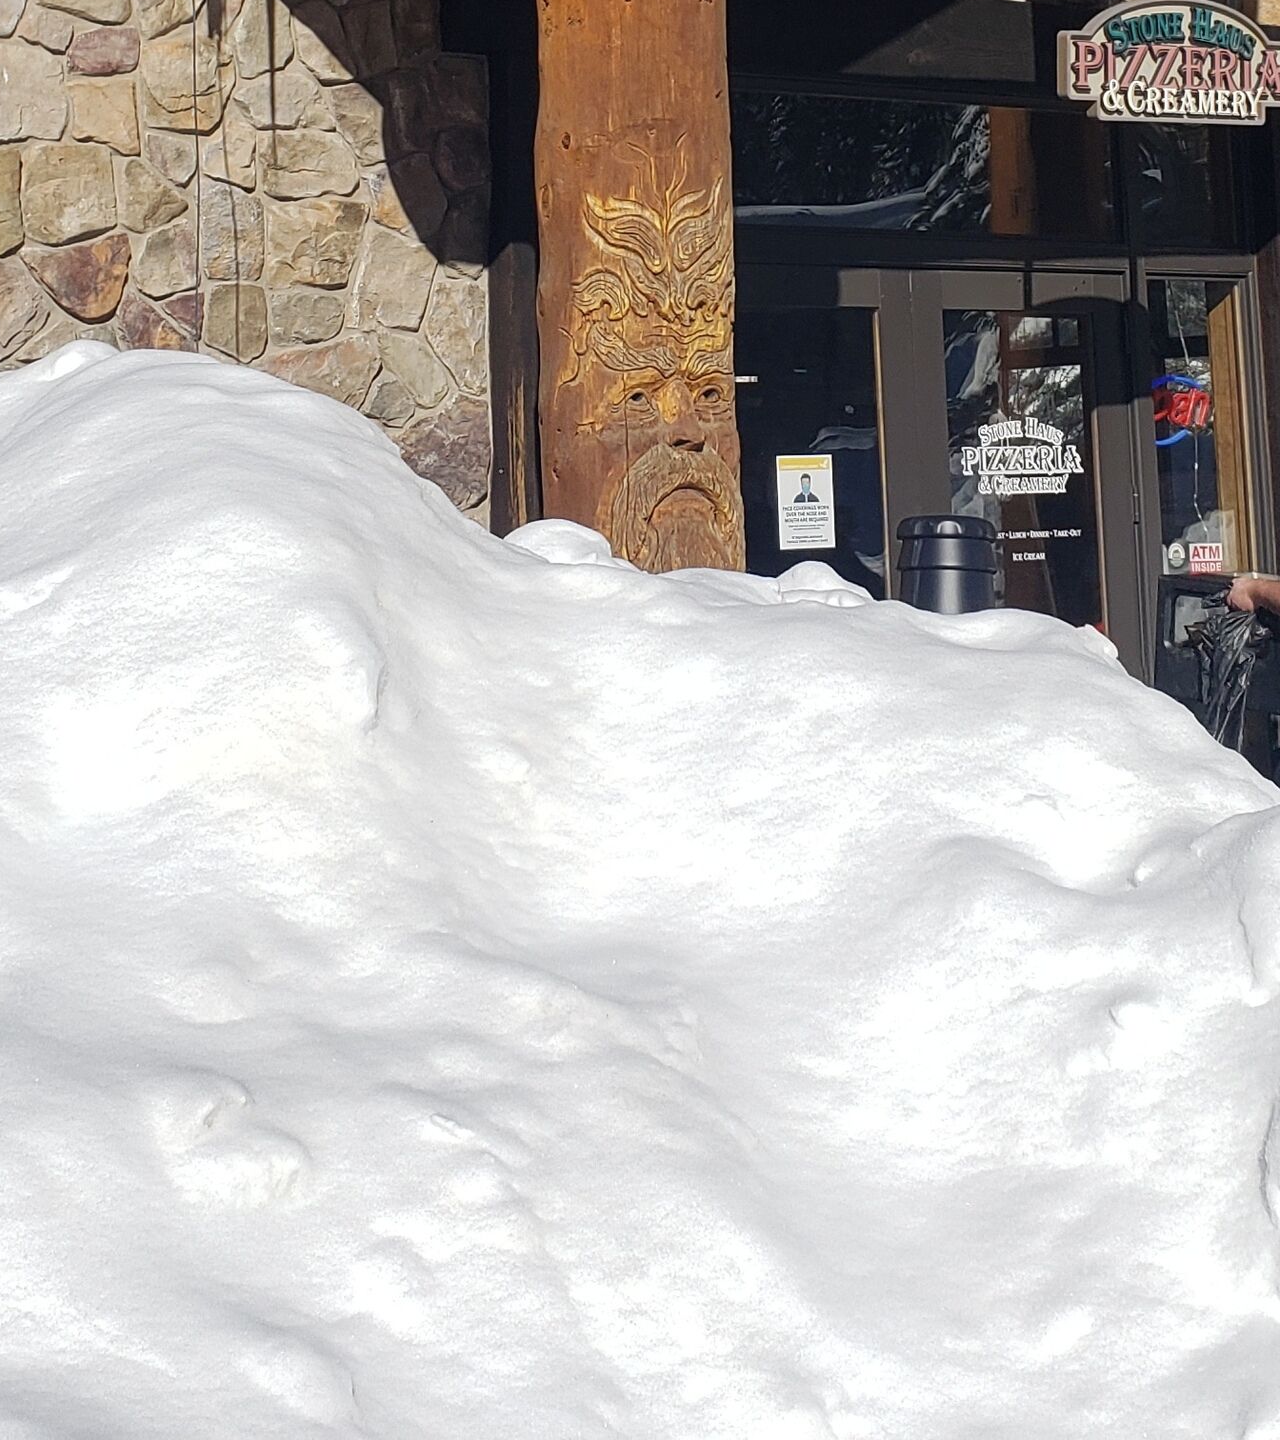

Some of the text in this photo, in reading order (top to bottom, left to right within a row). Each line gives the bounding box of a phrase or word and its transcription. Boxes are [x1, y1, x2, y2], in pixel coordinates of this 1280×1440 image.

[1104, 7, 1258, 60] STONE HAUS
[1103, 79, 1263, 116] & CREAMERY
[978, 416, 1064, 446] STONE HAUS
[961, 445, 1084, 475] PIZZERIA
[978, 474, 1069, 495] & CREAMERY
[1191, 562, 1222, 572] INSIDE
[1192, 545, 1221, 560] ATM
